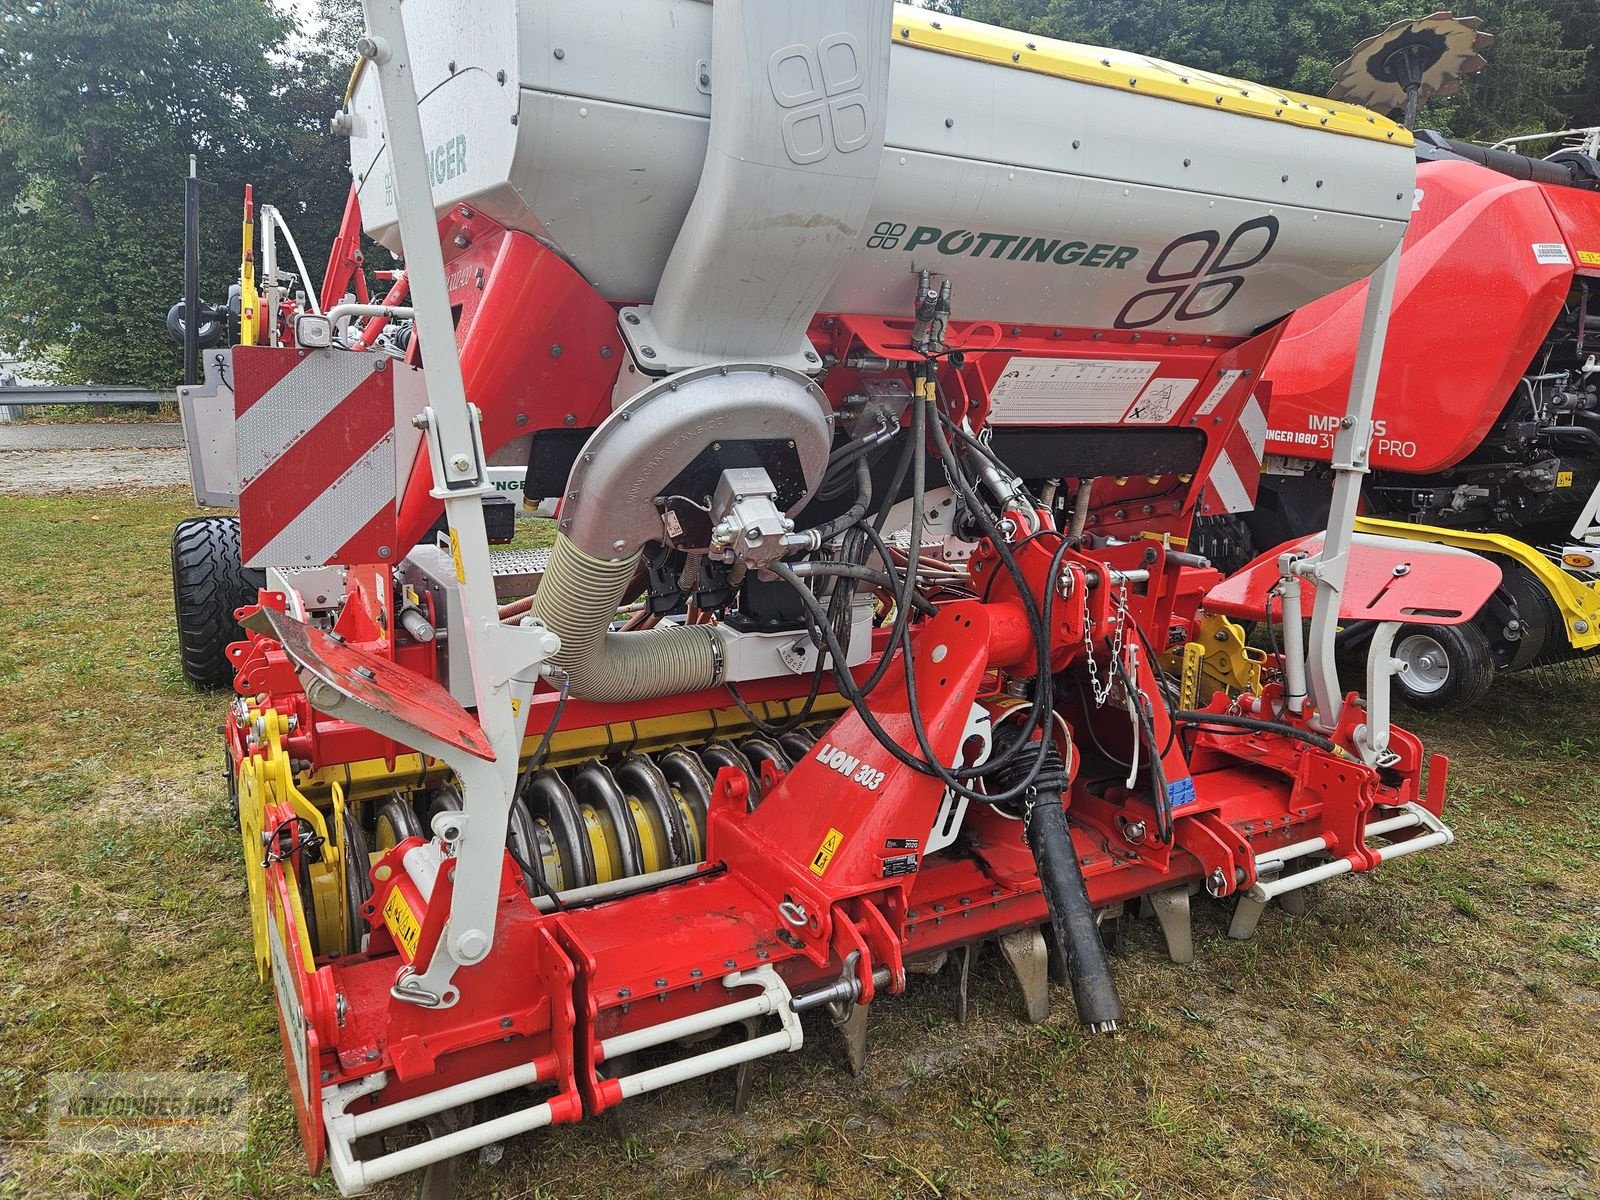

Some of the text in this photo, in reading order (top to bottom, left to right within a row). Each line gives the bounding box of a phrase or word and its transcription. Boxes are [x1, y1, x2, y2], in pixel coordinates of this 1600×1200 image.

[903, 226, 1139, 270] PÖTTINGER
[1294, 432, 1318, 445] 1880
[1378, 439, 1416, 458] PRO
[815, 743, 885, 791] LION 303
